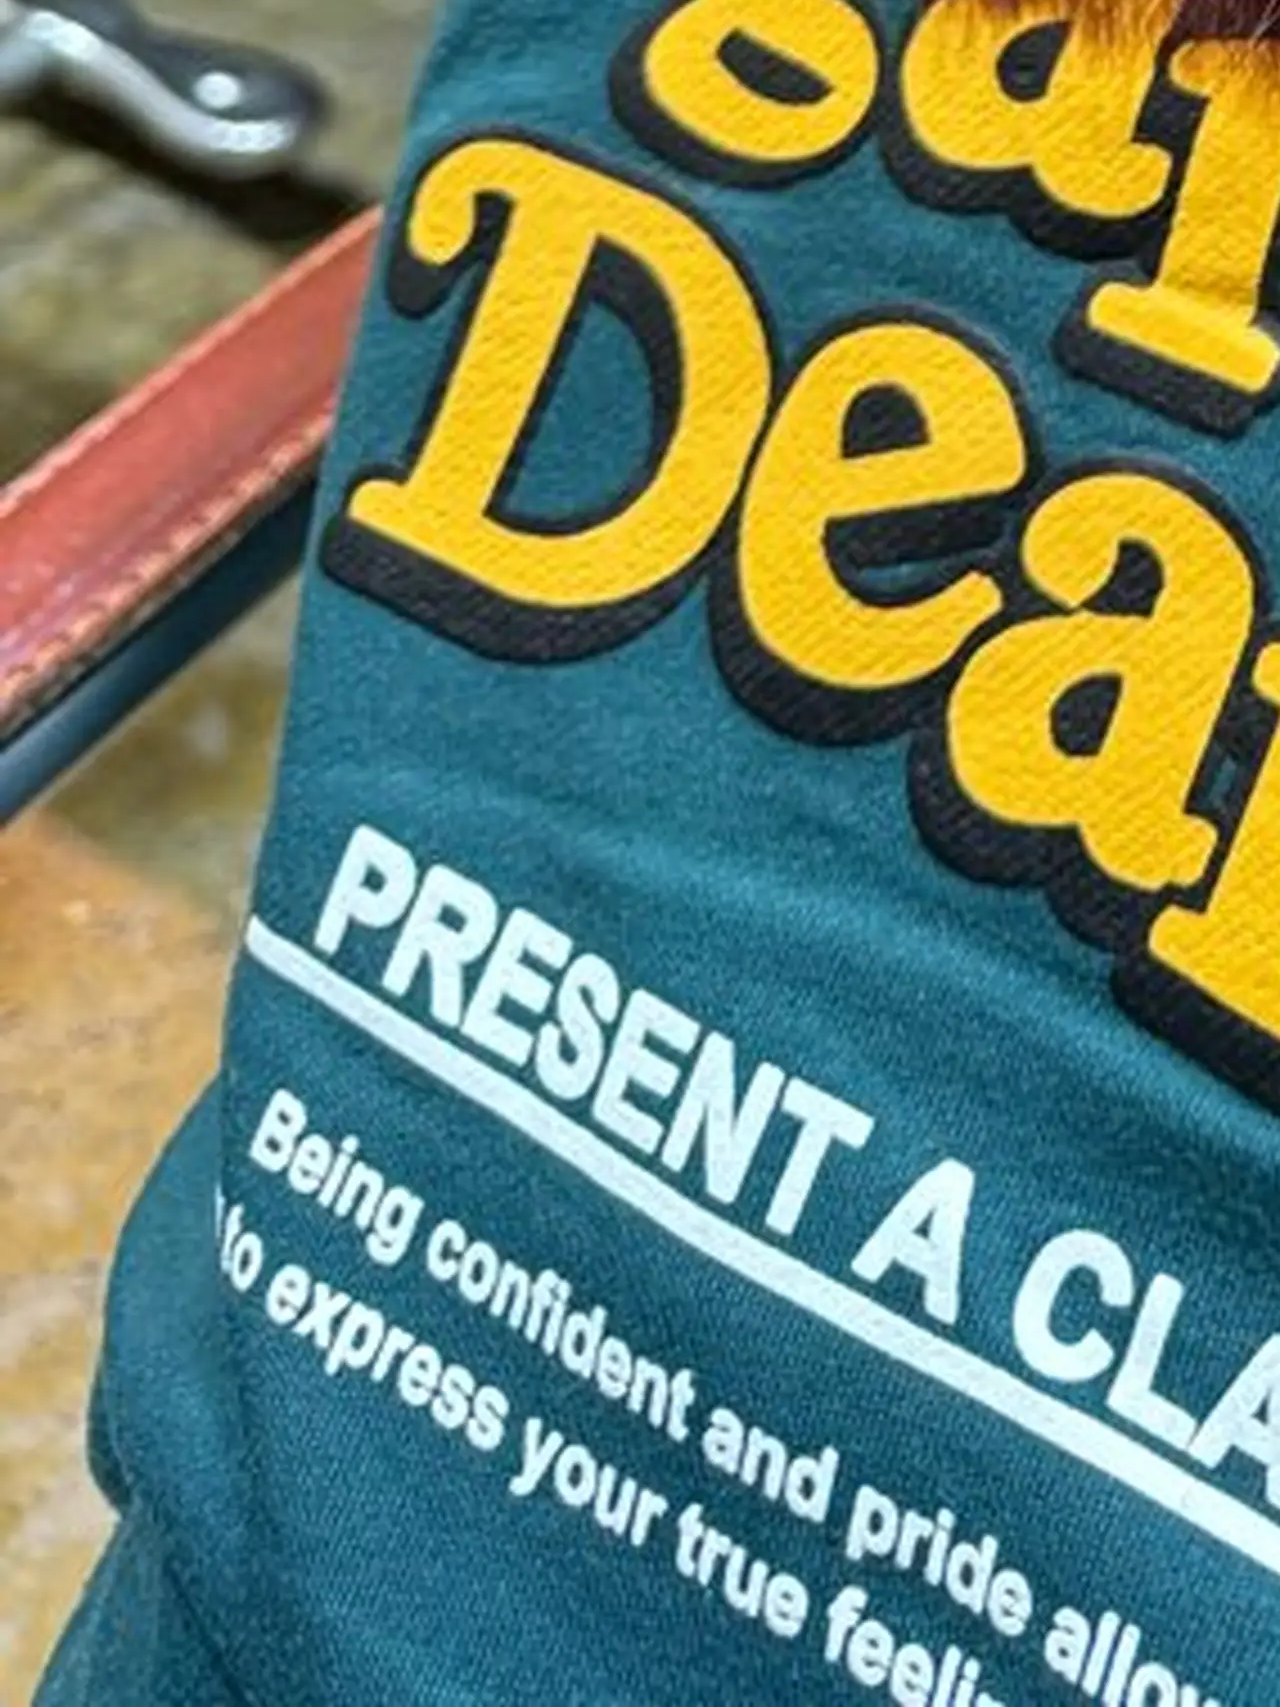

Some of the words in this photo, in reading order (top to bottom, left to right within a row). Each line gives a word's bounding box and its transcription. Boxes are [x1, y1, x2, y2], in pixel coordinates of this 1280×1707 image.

[312, 824, 876, 1238] PRESENT
[849, 1158, 977, 1326] A
[248, 1087, 426, 1266] Being
[426, 1218, 697, 1443] confident
[701, 1406, 839, 1524] and
[844, 1484, 1033, 1638] pride
[1043, 1605, 1222, 1707] allo
[264, 1263, 511, 1453] express
[508, 1416, 671, 1547] your
[675, 1502, 811, 1639] true
[823, 1584, 1007, 1707] feeli
